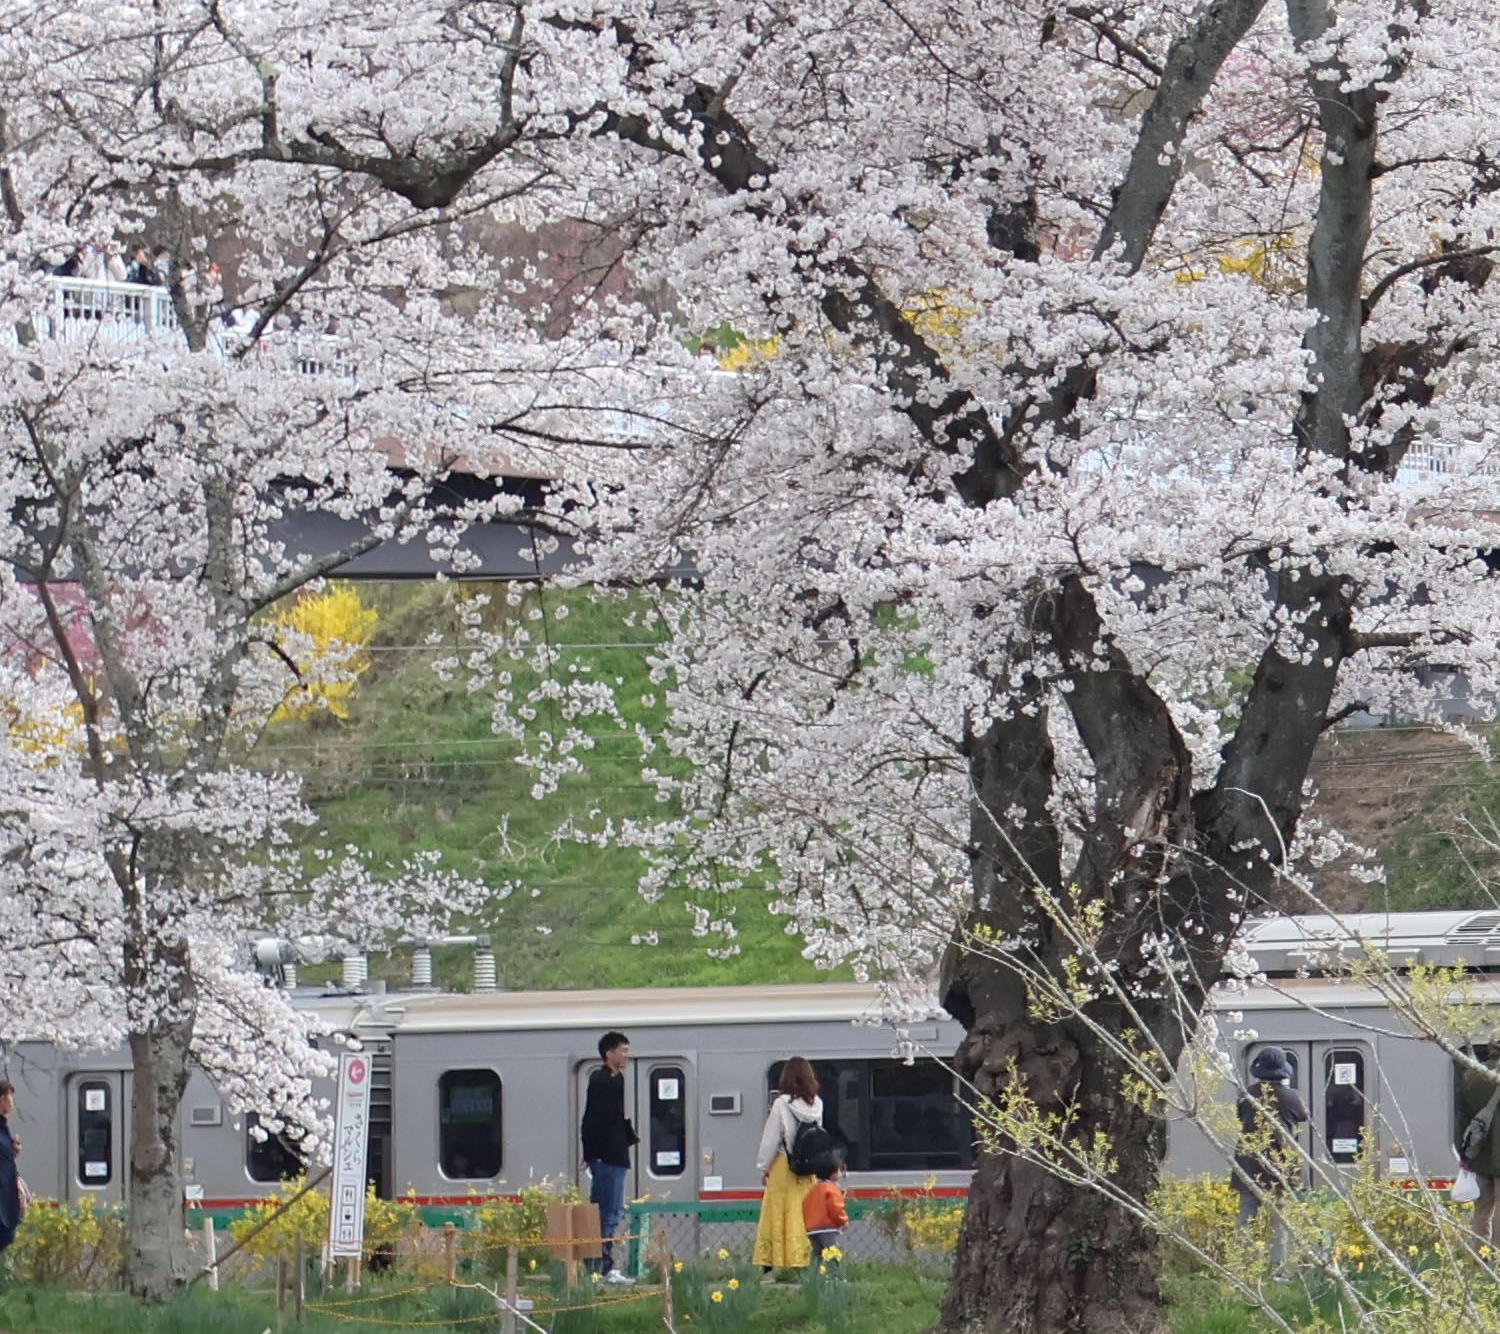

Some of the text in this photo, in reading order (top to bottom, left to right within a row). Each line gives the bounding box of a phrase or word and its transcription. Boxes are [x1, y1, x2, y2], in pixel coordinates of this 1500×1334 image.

[341, 1125, 354, 1172] マルシェ
[354, 1113, 364, 1165] さくら
